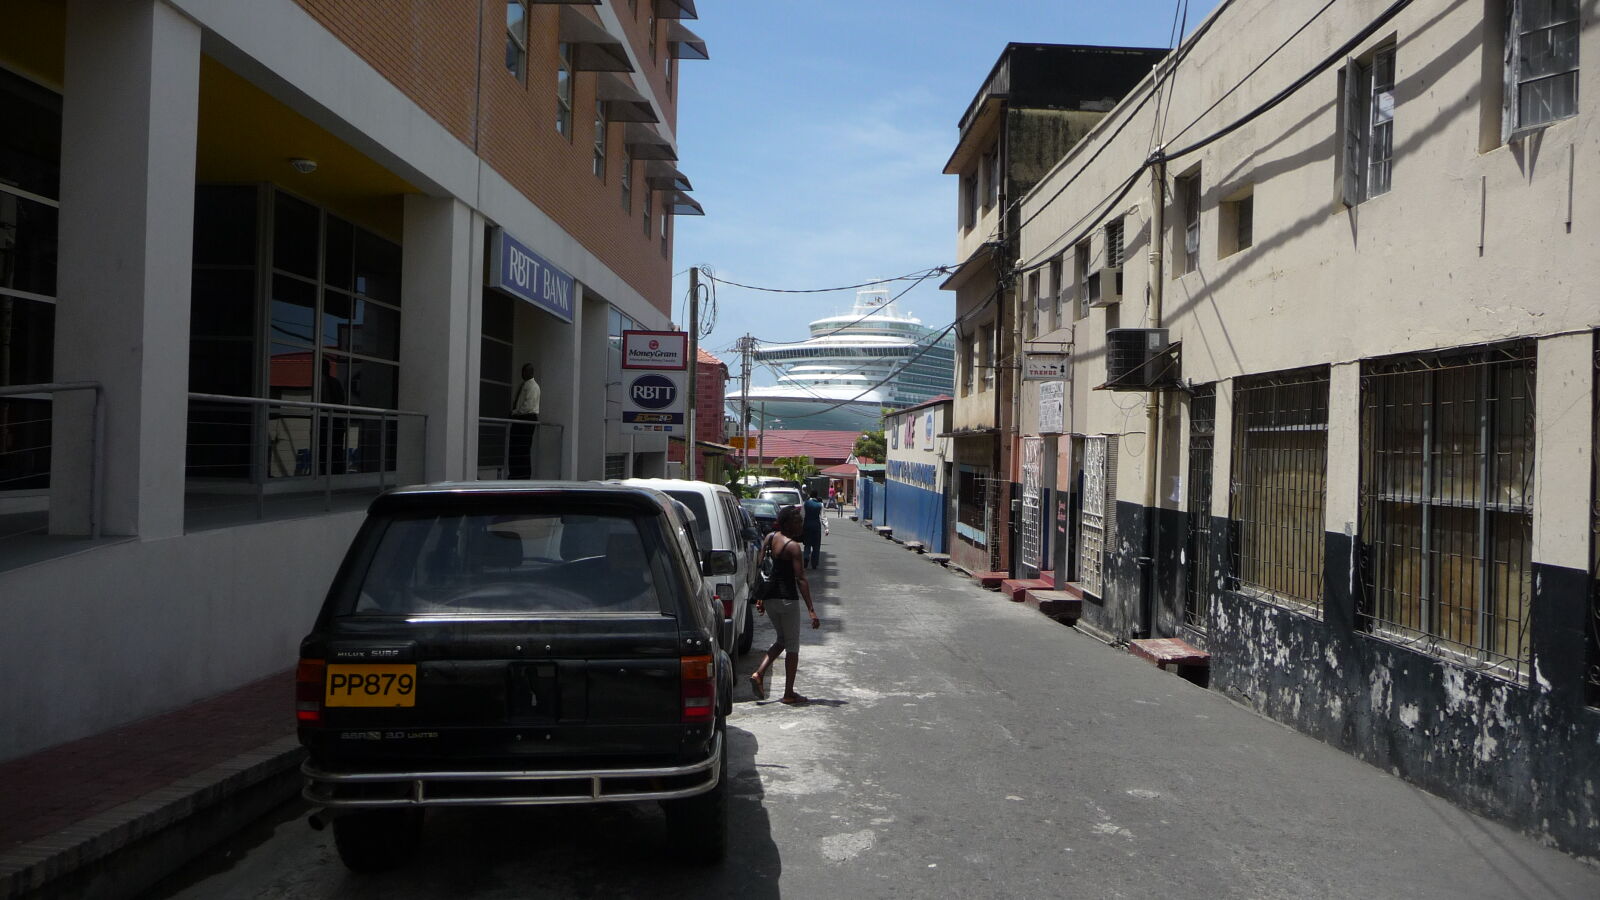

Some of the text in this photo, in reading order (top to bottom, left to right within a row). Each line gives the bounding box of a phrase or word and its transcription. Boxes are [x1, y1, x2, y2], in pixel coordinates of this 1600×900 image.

[510, 245, 569, 311] RBTT BANK
[628, 349, 677, 359] MoneyGram
[632, 385, 674, 400] RBTT
[370, 649, 400, 657] SURF
[330, 673, 414, 696] PP879
